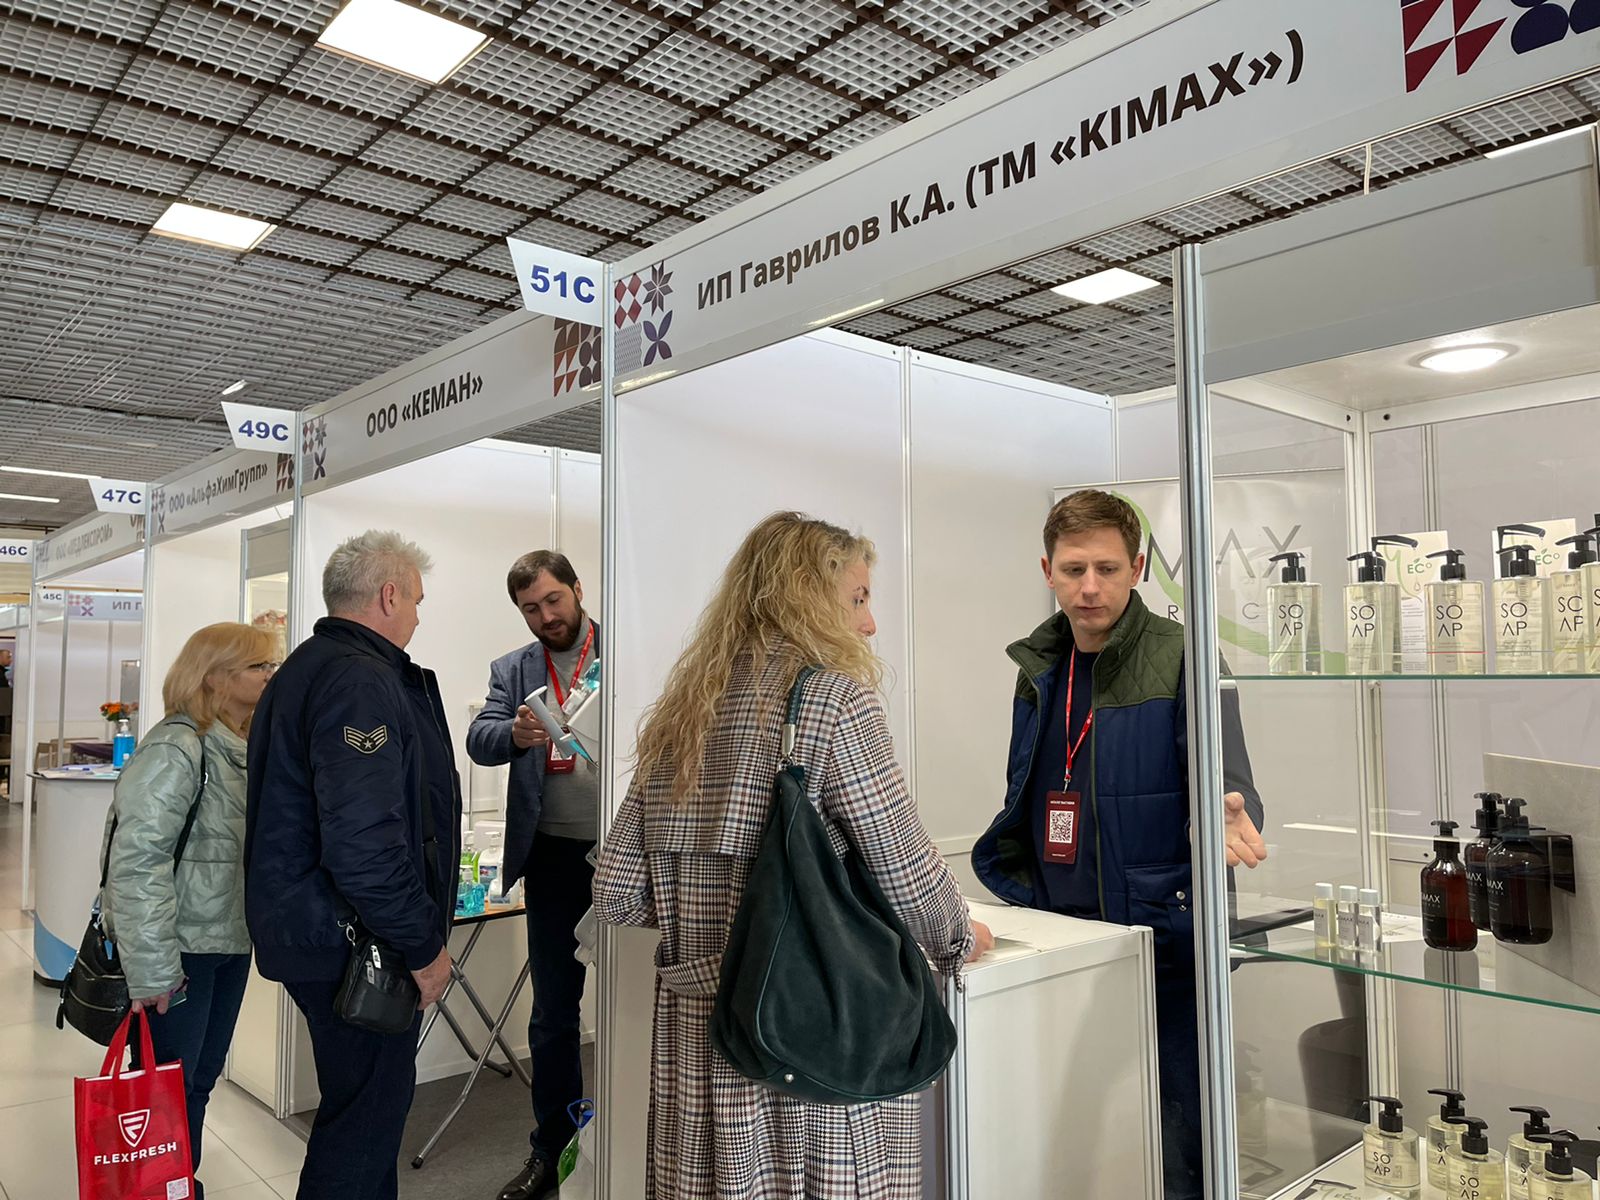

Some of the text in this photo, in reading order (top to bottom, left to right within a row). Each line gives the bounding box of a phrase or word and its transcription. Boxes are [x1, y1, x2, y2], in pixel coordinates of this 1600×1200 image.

[698, 29, 1305, 310] ИП Гаврилов К.А. (ТМ «KIMAX»)
[530, 264, 596, 304] 51C
[366, 371, 484, 438] ООО «КЕМАН»
[238, 420, 289, 442] 49C
[102, 488, 142, 504] 47C
[169, 463, 268, 513] ООО «АльфаХимГрупп»
[0, 546, 28, 556] 46C
[43, 593, 62, 601] 45C
[94, 1141, 177, 1165] FLEXFRESH
